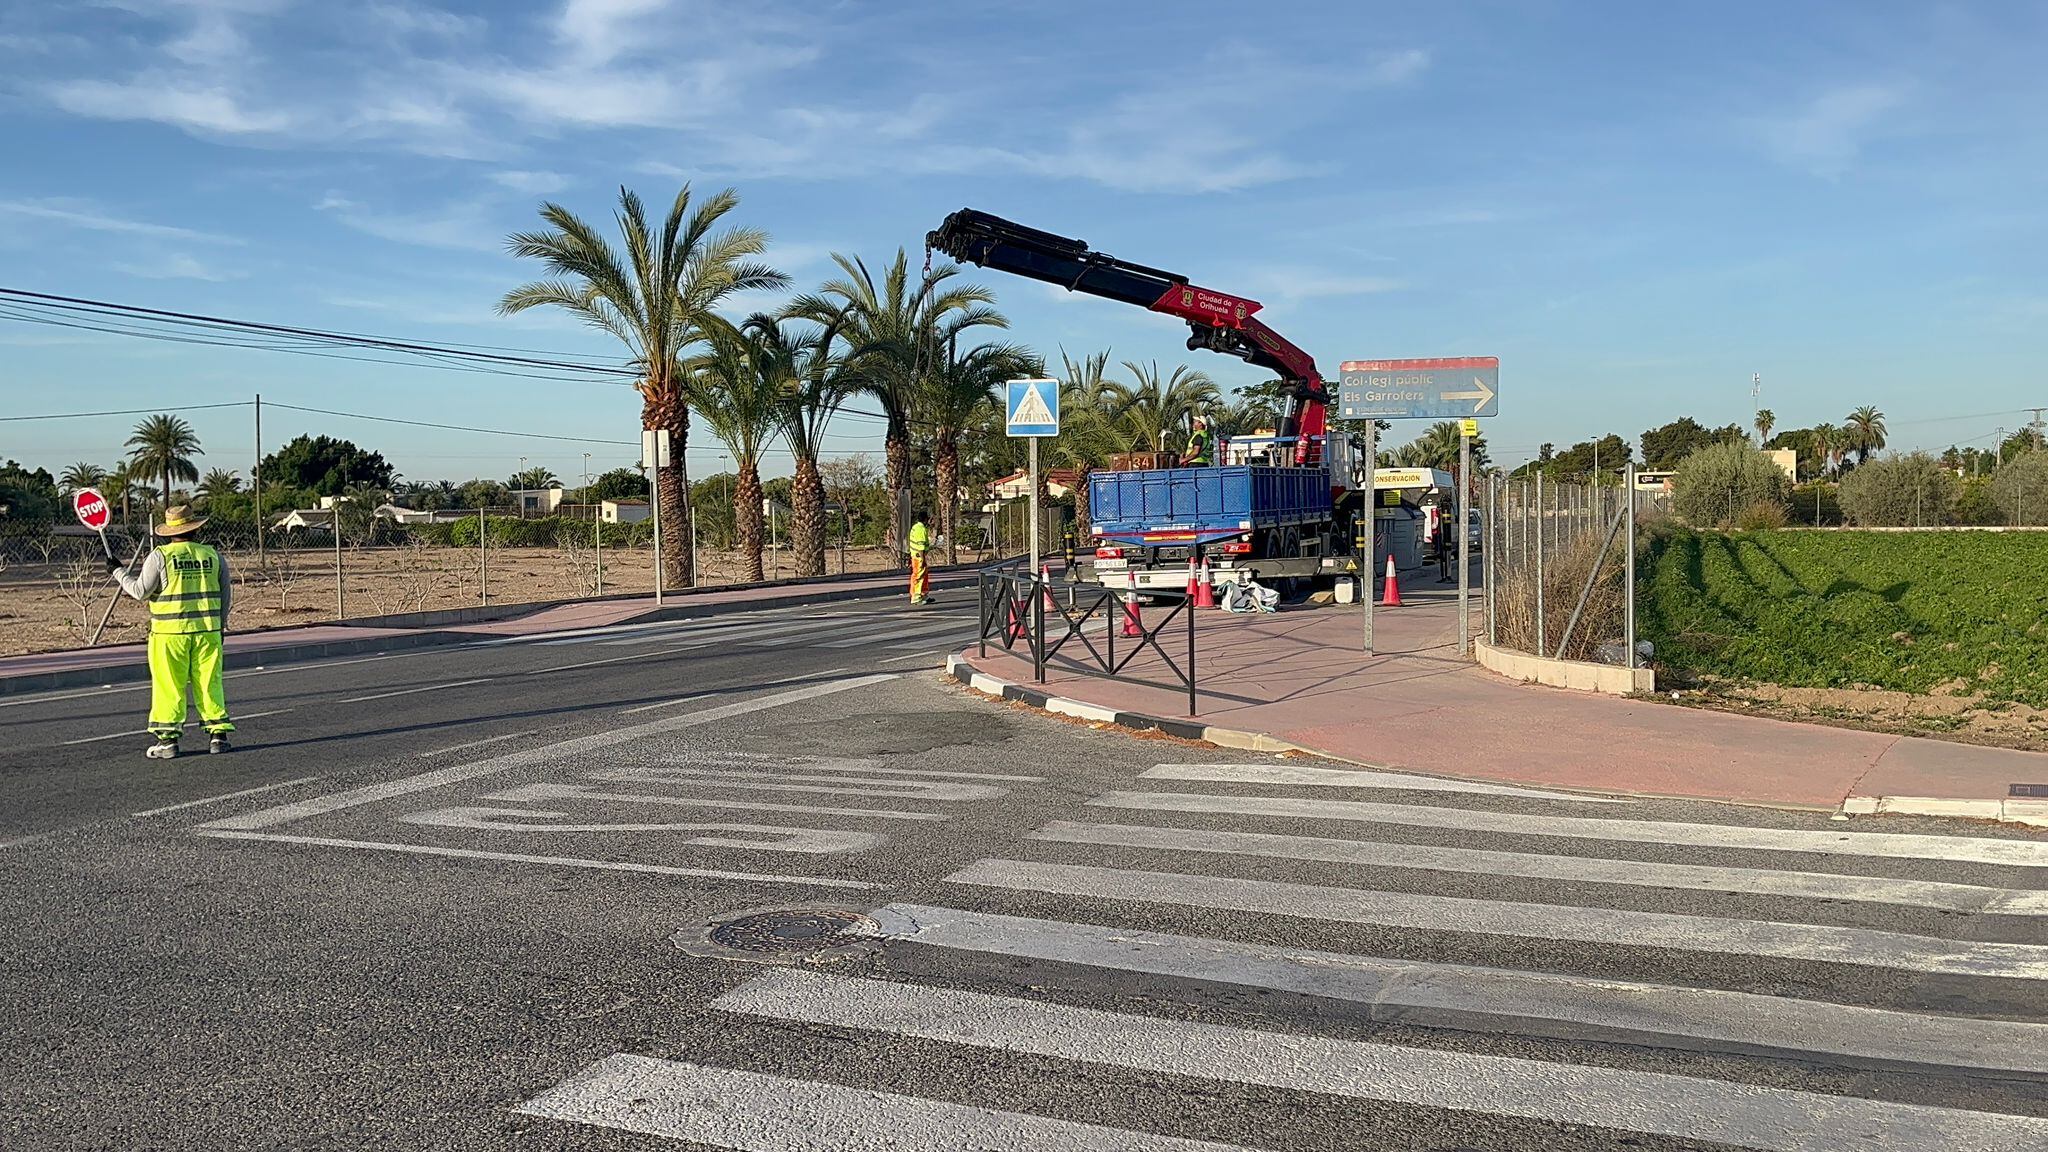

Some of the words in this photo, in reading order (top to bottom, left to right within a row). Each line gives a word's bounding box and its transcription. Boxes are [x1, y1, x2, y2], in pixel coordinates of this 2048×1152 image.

[1197, 292, 1222, 304] Ciudad
[1223, 299, 1233, 307] de
[1199, 302, 1228, 314] Orihuela
[1396, 373, 1434, 387] públic
[1344, 391, 1361, 402] Els
[1365, 390, 1424, 401] Garrofers
[1374, 475, 1421, 483] ONSERVACIÓN
[78, 500, 104, 518] STOP
[172, 554, 213, 570] ismael
